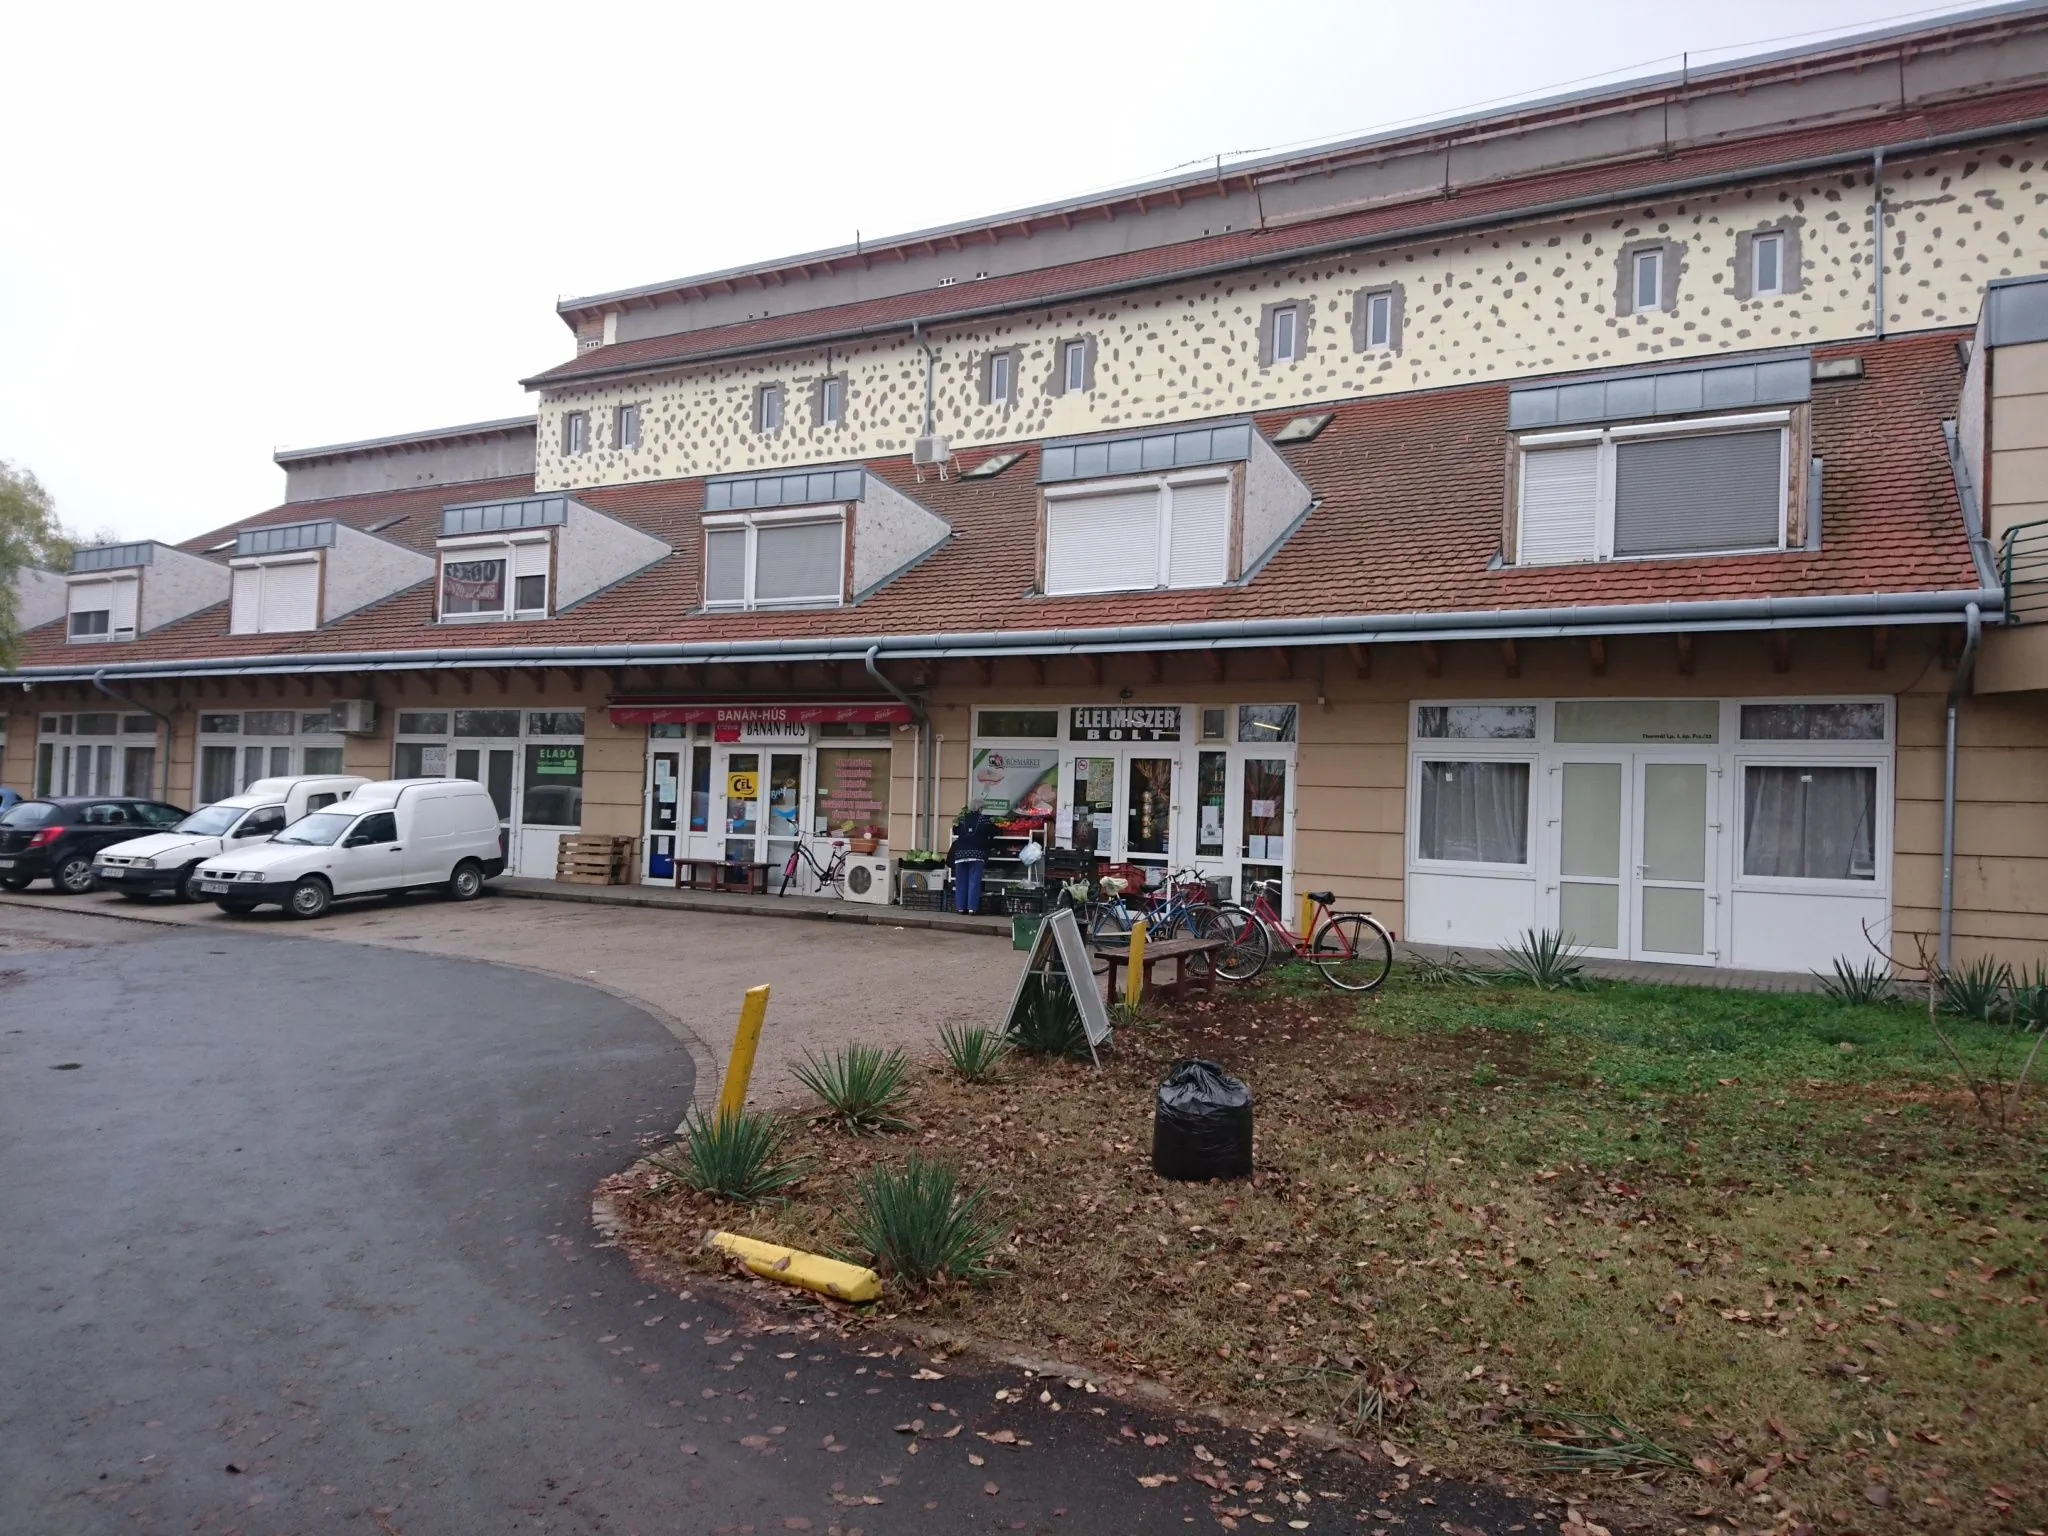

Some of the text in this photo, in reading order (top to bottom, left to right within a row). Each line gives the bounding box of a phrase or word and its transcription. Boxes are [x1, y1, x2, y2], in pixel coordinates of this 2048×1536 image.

[717, 707, 787, 721] BANÁN-HÚS
[1075, 707, 1175, 728] ÉLELMISZER
[1087, 729, 1162, 740] BOLT
[540, 746, 576, 758] ELADÓ
